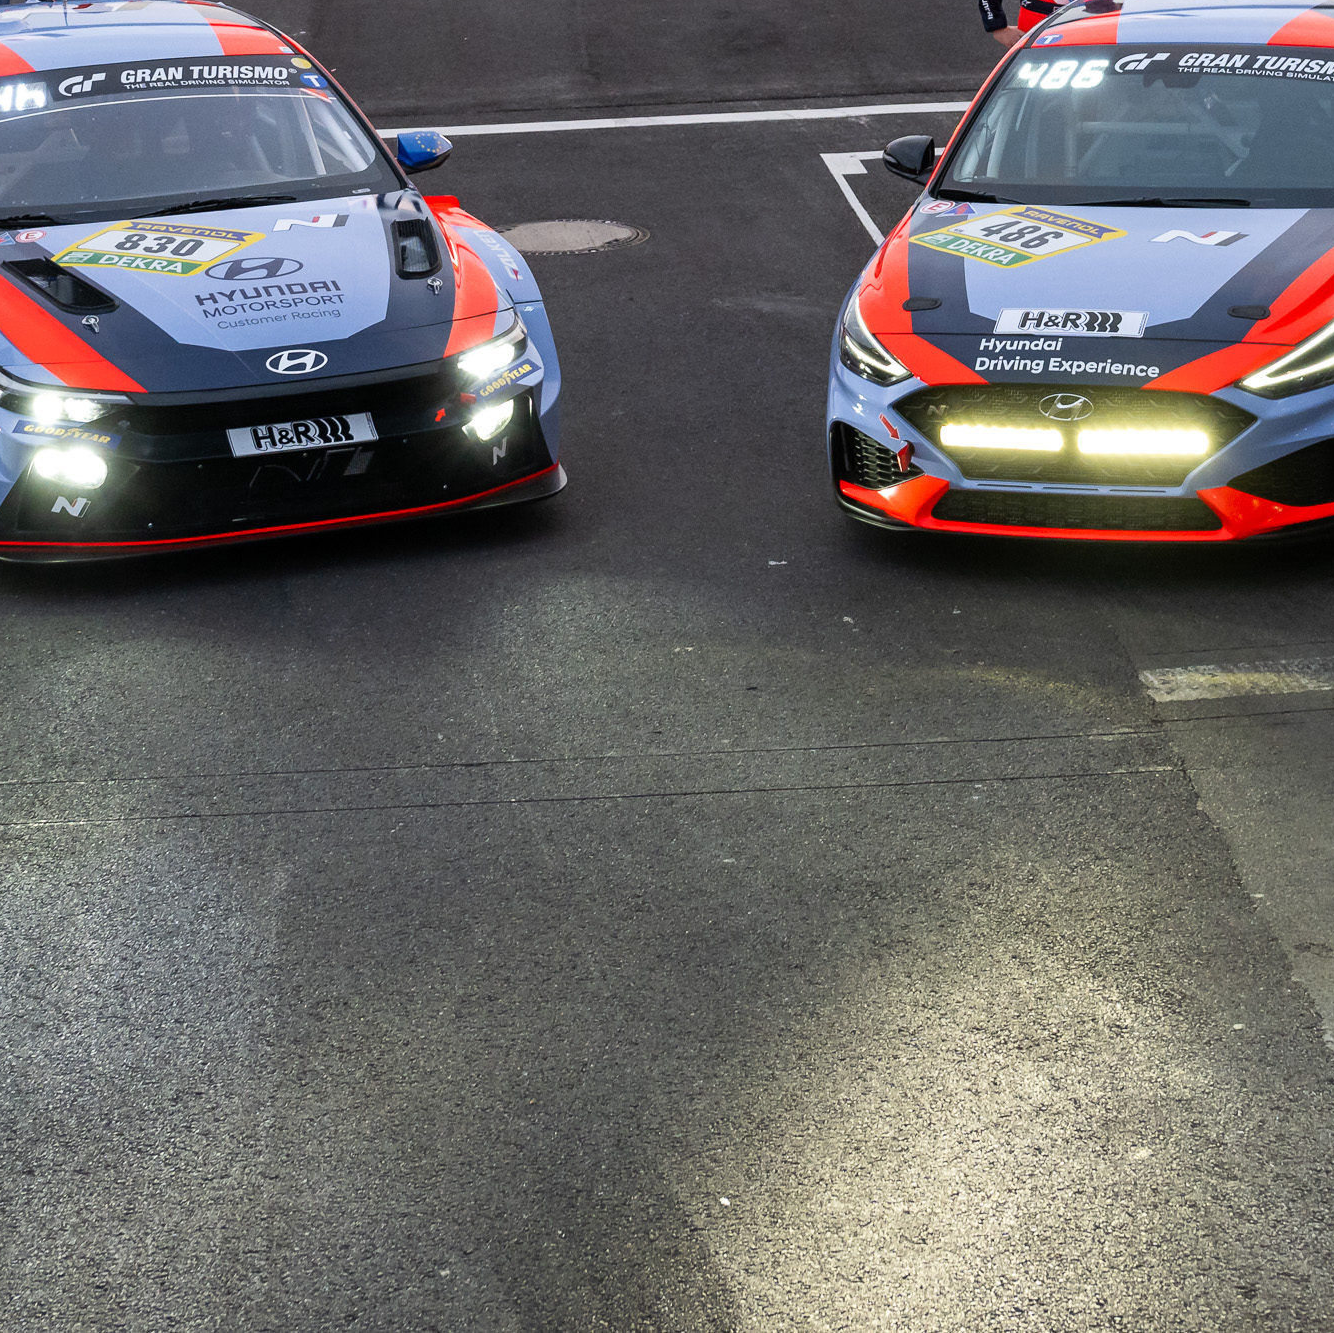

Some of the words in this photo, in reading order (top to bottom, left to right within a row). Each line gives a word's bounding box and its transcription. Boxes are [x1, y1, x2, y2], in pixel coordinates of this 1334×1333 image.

[1178, 53, 1252, 68] GRAN
[120, 67, 188, 84] GRAN
[190, 65, 288, 81] TURISMO
[180, 79, 224, 87] DRIVING
[228, 79, 291, 87] SIMULATOR
[304, 74, 324, 88] T
[1017, 59, 1110, 89] 486
[1198, 67, 1233, 75] REAL
[1236, 69, 1283, 78] DRIVING
[137, 222, 241, 240] RAVENOL
[1024, 209, 1101, 236] RAVENOL
[115, 233, 205, 257] 830
[980, 220, 1064, 249] 486
[473, 229, 524, 282] FALKEN
[949, 237, 1017, 265] DEKRA
[98, 254, 183, 273] DEKRA
[195, 280, 342, 306] HYUNDAI
[202, 294, 345, 319] MOTORSPORT
[217, 314, 287, 329] Customer
[291, 308, 341, 320] Racing
[1021, 311, 1081, 331] H&R
[979, 337, 1063, 353] Hyundai
[975, 357, 1044, 373] Driving
[1049, 358, 1160, 378] Experience
[479, 363, 533, 398] GOODYEAR
[23, 424, 111, 444] GOODYEAR
[251, 420, 316, 451] H&R
